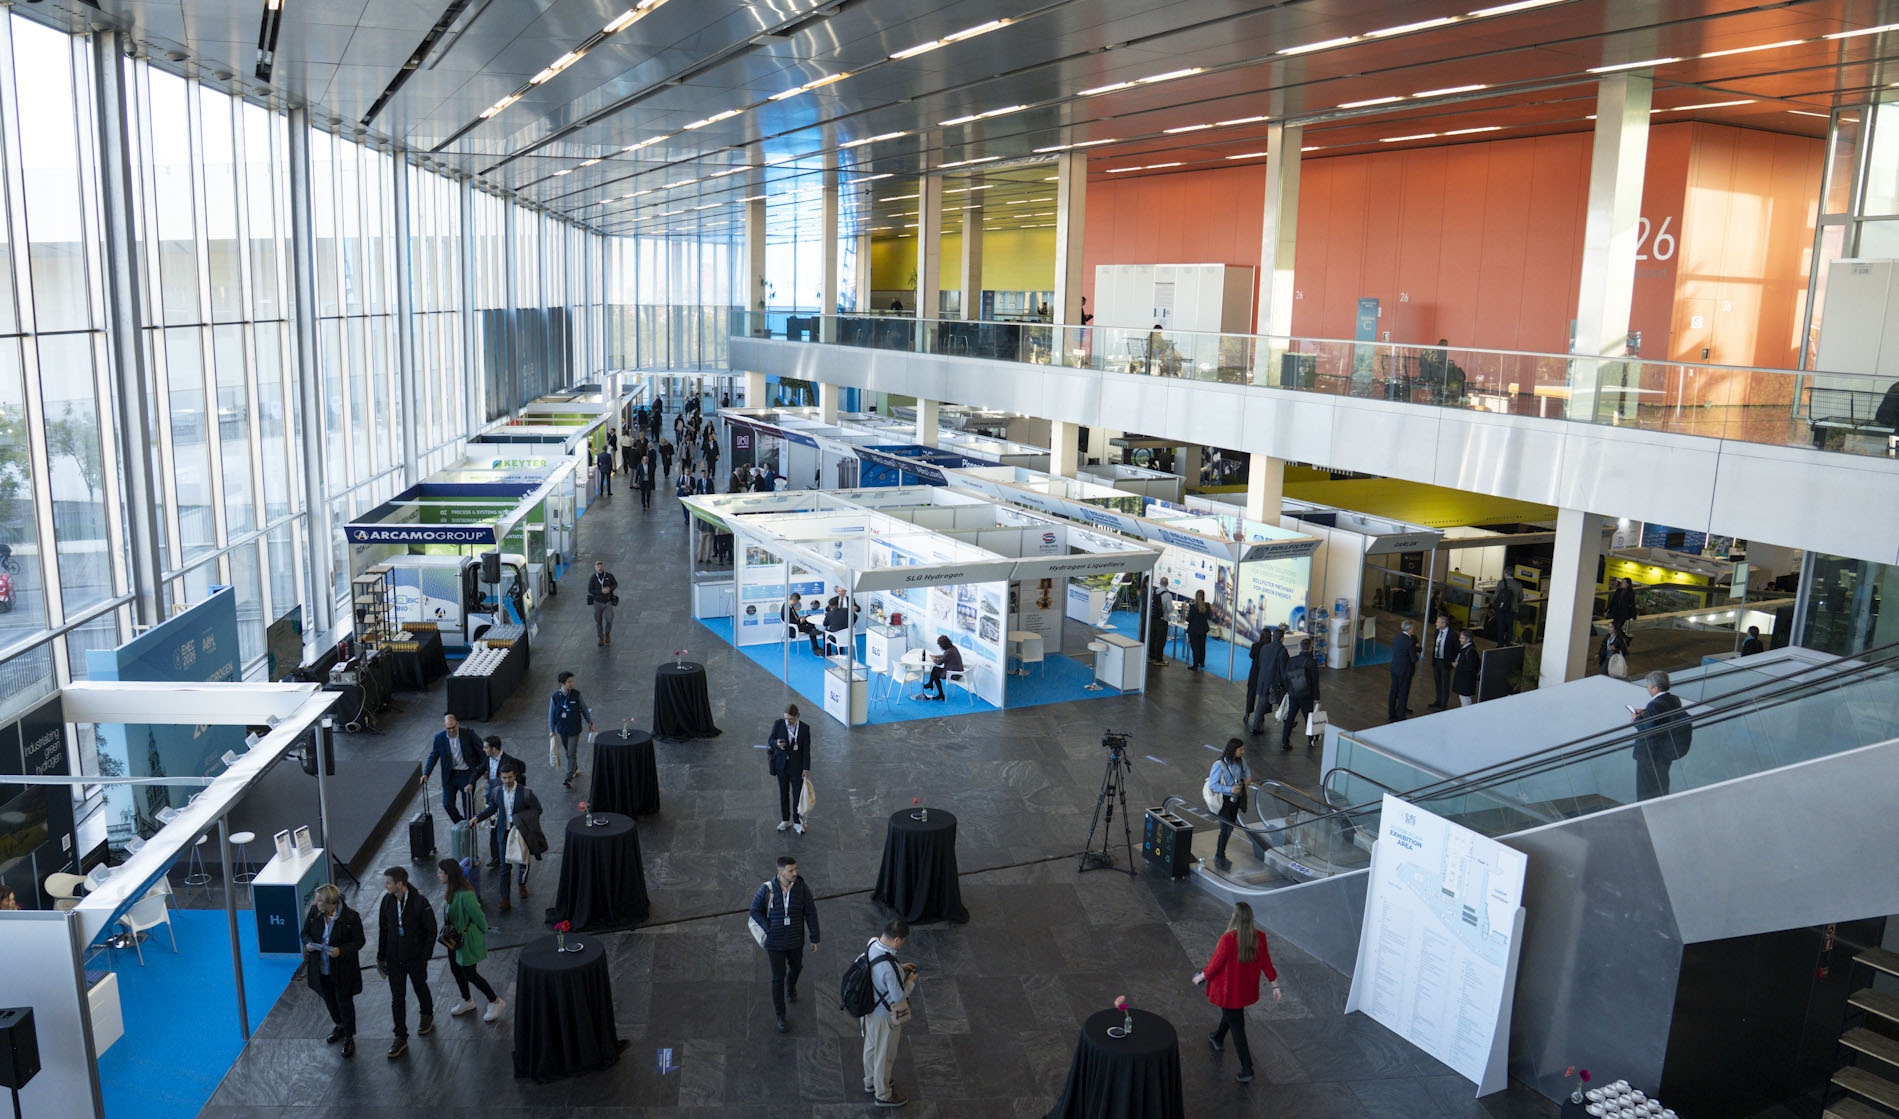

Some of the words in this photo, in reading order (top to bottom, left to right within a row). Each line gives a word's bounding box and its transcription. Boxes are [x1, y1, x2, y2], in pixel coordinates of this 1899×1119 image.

[1636, 216, 1676, 261] 26
[1296, 290, 1305, 300] 26
[1400, 292, 1409, 303] 26
[504, 459, 547, 468] KEYTER
[1049, 563, 1086, 572] Hydrogen
[1087, 561, 1126, 570] Liquefiers
[924, 572, 964, 581] Hydrogen
[830, 691, 839, 703] SLG
[44, 741, 61, 759] green
[1389, 830, 1423, 849] EXHIBITION
[1397, 840, 1414, 852] AREA
